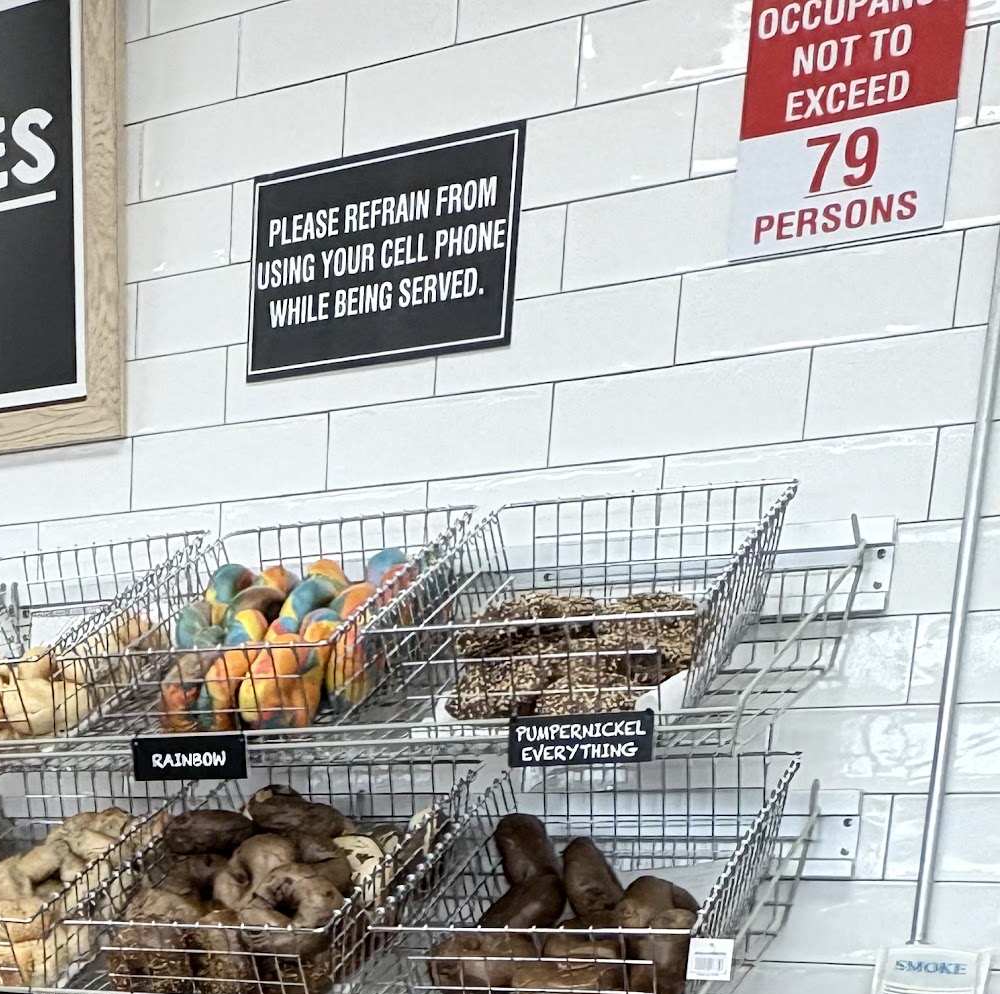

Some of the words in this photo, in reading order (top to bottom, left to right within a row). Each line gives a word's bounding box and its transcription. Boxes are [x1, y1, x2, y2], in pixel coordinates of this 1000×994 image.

[758, 0, 934, 40] OCCUPA
[792, 34, 862, 78] NOT
[869, 23, 913, 61] TO
[784, 69, 910, 123] EXCEED
[806, 126, 879, 194] 79
[268, 206, 340, 248] PLEASE
[344, 189, 430, 234] REFRAIN
[435, 175, 498, 217] FROM
[753, 190, 918, 245] PERSONS
[257, 253, 315, 290] USING
[321, 242, 375, 279] YOUR
[380, 232, 428, 270] CELL
[435, 218, 507, 260] PHONE
[269, 292, 330, 329] WHILE
[334, 281, 392, 319] BEING
[398, 267, 484, 308] SERVED.
[515, 719, 647, 742] PUMPERNICKEL
[521, 741, 638, 762] EVERYTHING
[151, 750, 227, 769] RAINBOW
[895, 960, 968, 975] SMOKE
